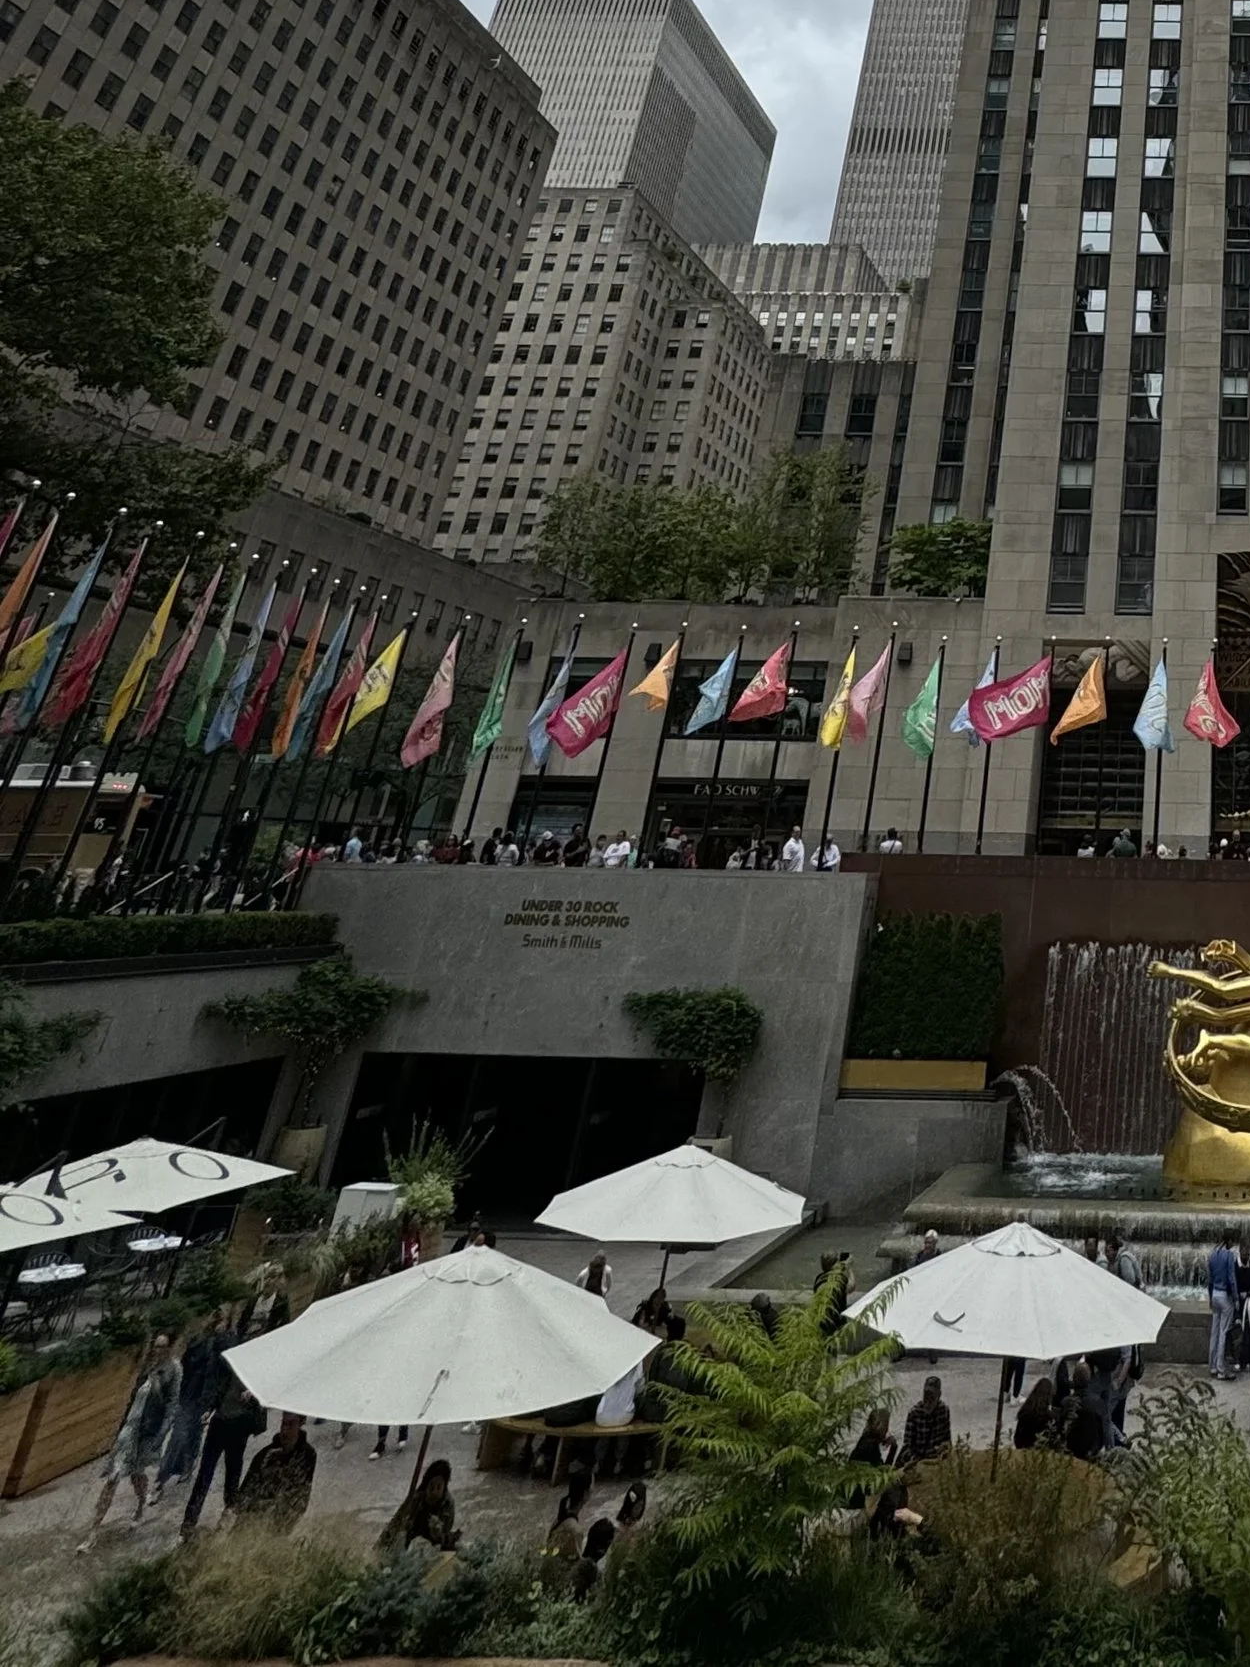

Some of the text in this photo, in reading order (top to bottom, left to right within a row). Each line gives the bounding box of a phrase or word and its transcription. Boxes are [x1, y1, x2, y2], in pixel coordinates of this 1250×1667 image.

[522, 899, 620, 913] UNDER 30 ROCK
[504, 914, 630, 928] DINING & SHOPPING
[522, 934, 557, 948] Smith
[570, 935, 602, 949] Mills
